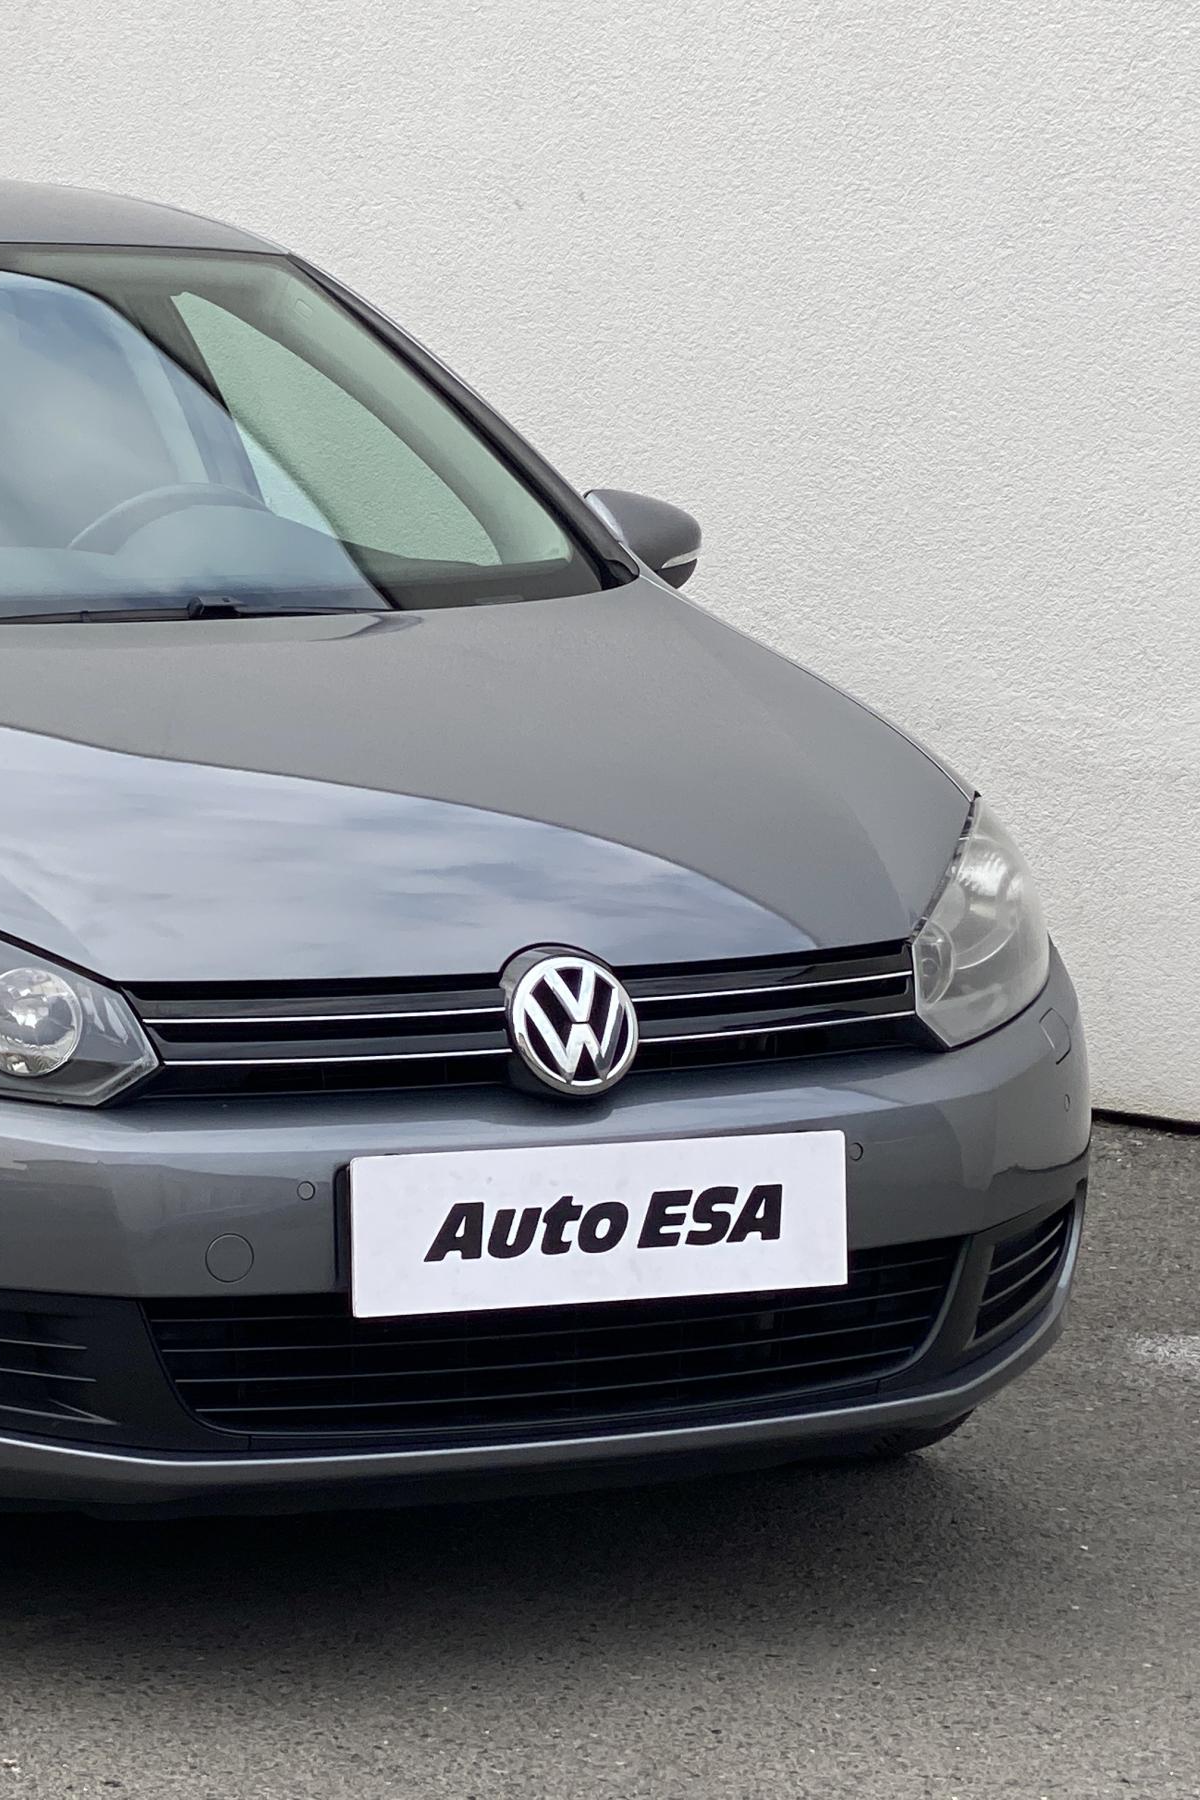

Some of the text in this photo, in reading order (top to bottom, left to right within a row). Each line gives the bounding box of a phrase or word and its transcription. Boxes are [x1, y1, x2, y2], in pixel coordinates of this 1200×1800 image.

[513, 959, 636, 1089] VW
[423, 1184, 783, 1262] Auto ESA
